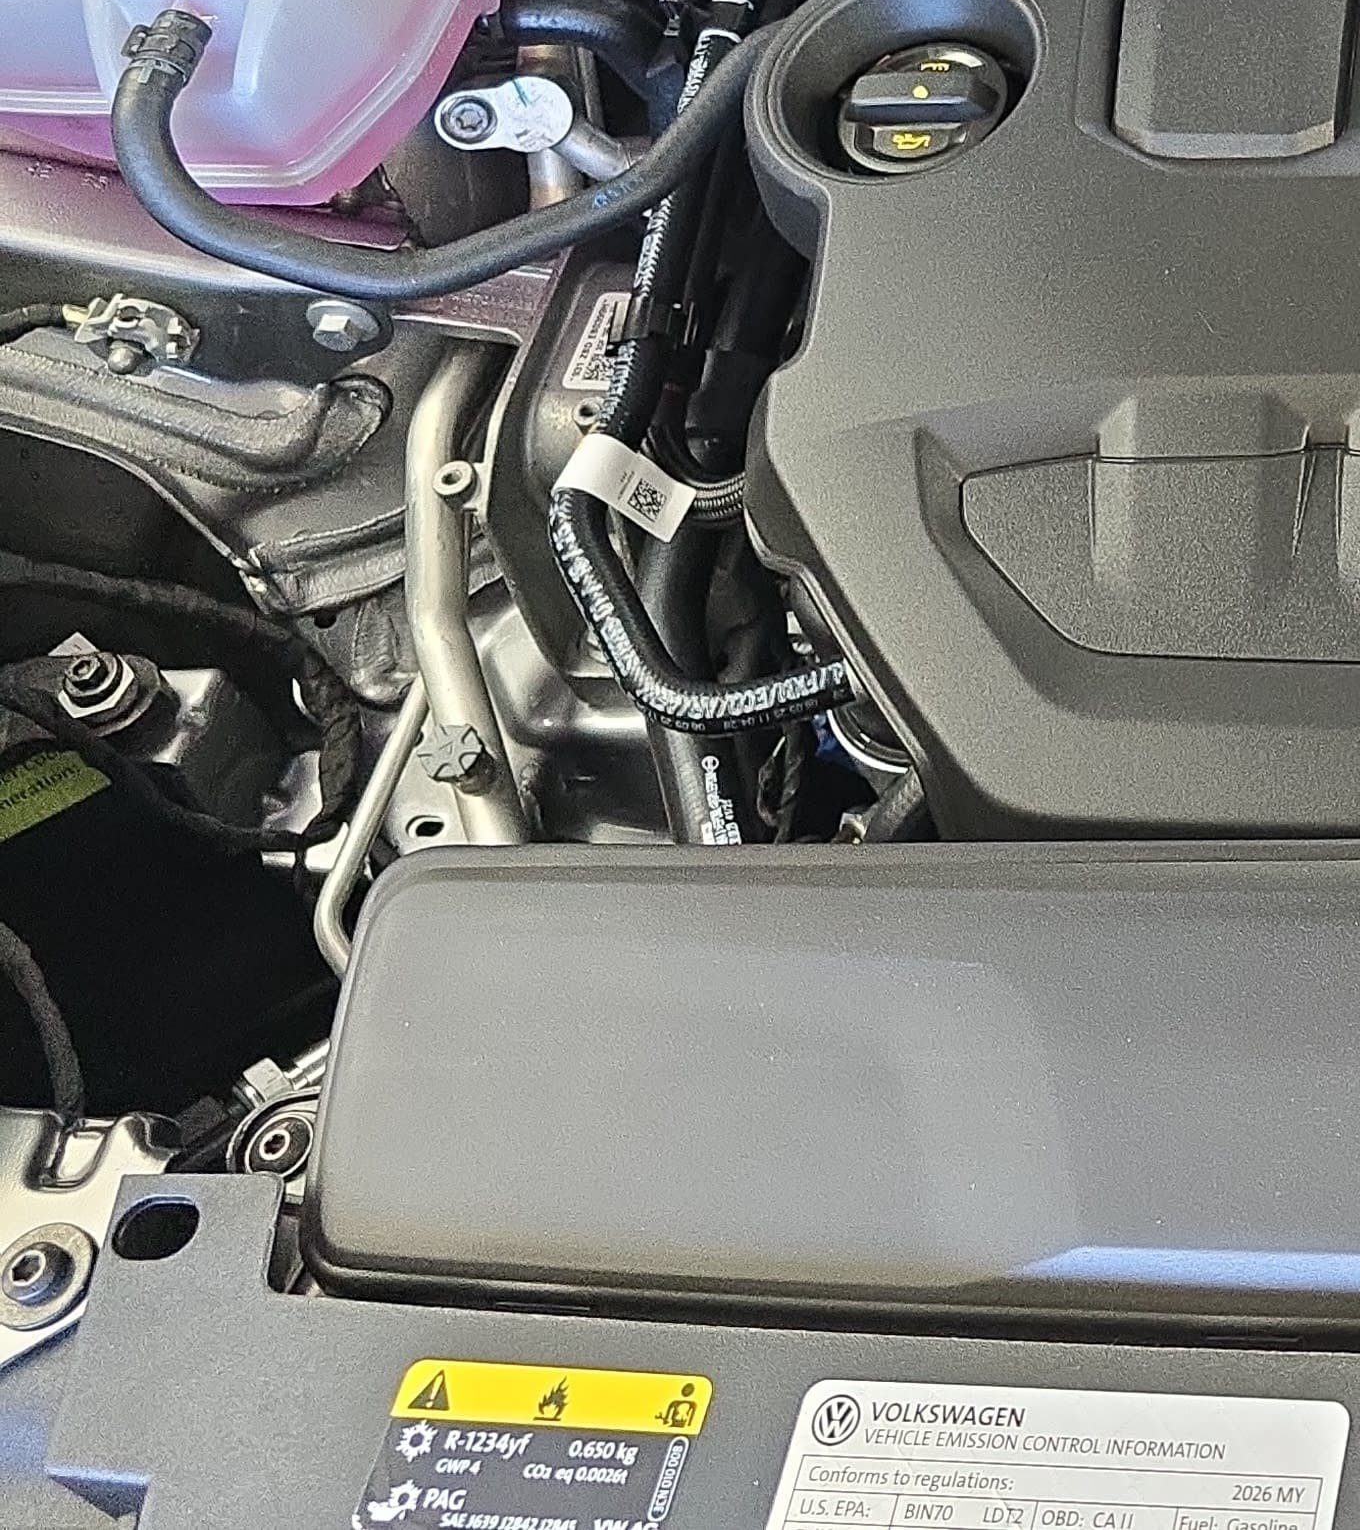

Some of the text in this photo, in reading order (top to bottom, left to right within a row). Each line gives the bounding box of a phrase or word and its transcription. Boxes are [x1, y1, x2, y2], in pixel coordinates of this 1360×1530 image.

[871, 1402, 1026, 1428] VOLKSWAGEN
[444, 1430, 639, 1466] R-1234yf 0.650 kg
[864, 1428, 1227, 1460] VEHICLE EMISSION CONTROL INFORMATION
[435, 1458, 469, 1474] GWP
[470, 1460, 481, 1475] 4
[554, 1467, 573, 1486] eq
[808, 1465, 1015, 1492] Conforms to regulations:
[422, 1488, 467, 1511] PAG
[1232, 1485, 1306, 1504] 2026 MY
[439, 1512, 465, 1528] SAE
[800, 1499, 872, 1518] U.S. EPA:
[904, 1504, 1024, 1525] BIN70 LDT2
[1041, 1510, 1085, 1527] OBD:
